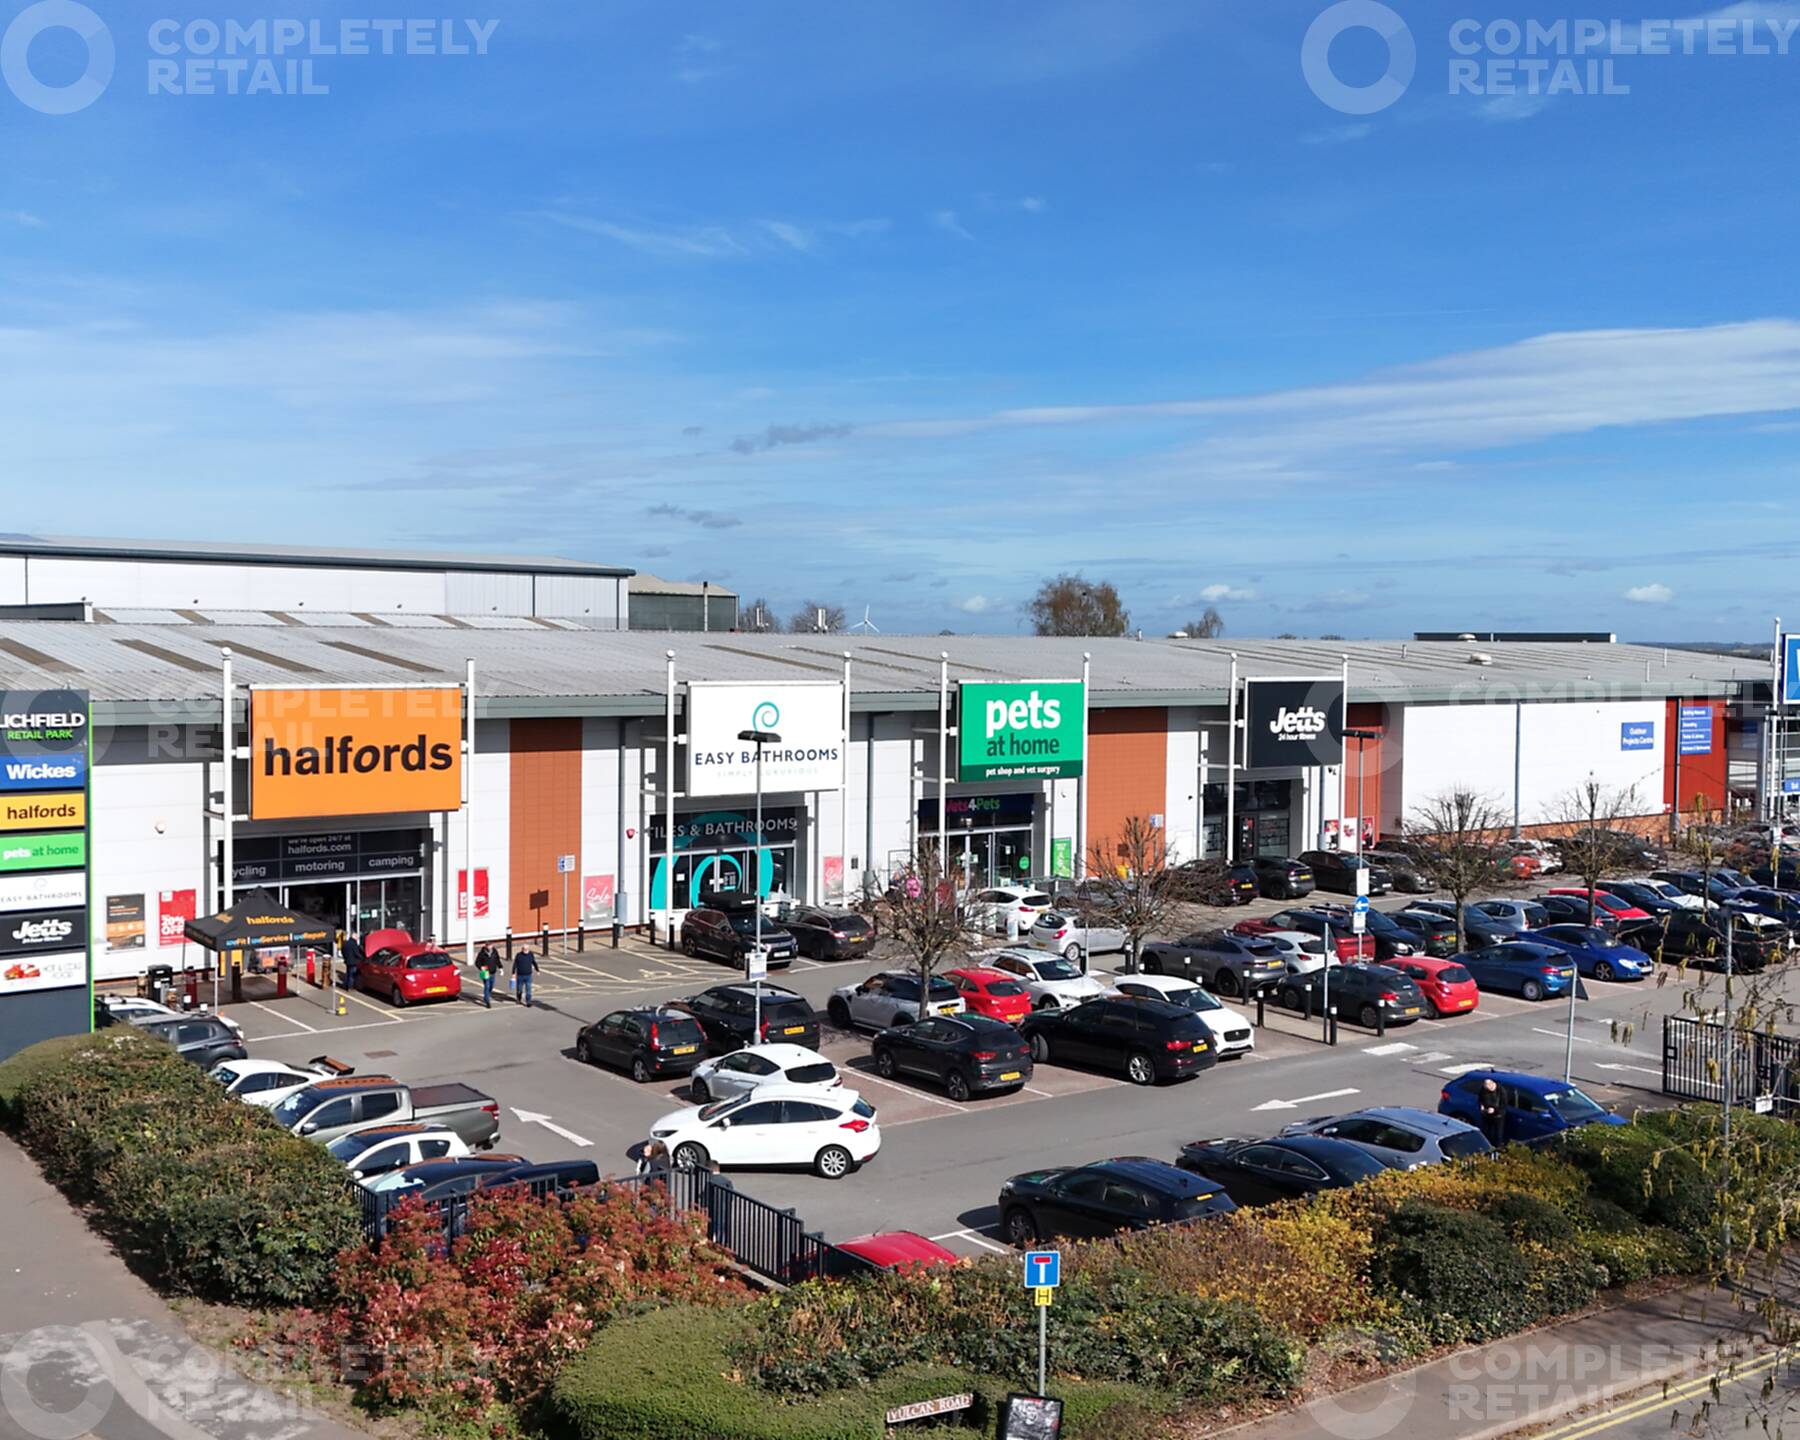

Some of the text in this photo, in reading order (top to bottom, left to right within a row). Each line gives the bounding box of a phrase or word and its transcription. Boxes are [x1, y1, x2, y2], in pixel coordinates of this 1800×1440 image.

[0, 713, 85, 728] ICHFIELD
[986, 690, 1061, 738] pets
[1270, 706, 1325, 734] Jetts
[7, 729, 73, 740] RETAIL PARK
[987, 733, 1060, 757] at home
[264, 734, 453, 776] halfords
[695, 748, 838, 766] EASY BATHROOMS
[6, 763, 76, 780] Wickes
[1013, 765, 1025, 774] and
[7, 804, 76, 819] halfords
[690, 824, 700, 836] &
[705, 818, 796, 836] BATHROOMS
[3, 844, 78, 860] pets at home
[287, 843, 352, 855] halfords.com
[295, 860, 345, 873] motoring
[368, 855, 414, 868] camping
[231, 864, 267, 878] ycling
[246, 916, 295, 925] halfords
[12, 919, 72, 940] Jetts
[890, 1394, 971, 1420] VULCAN ROAD
